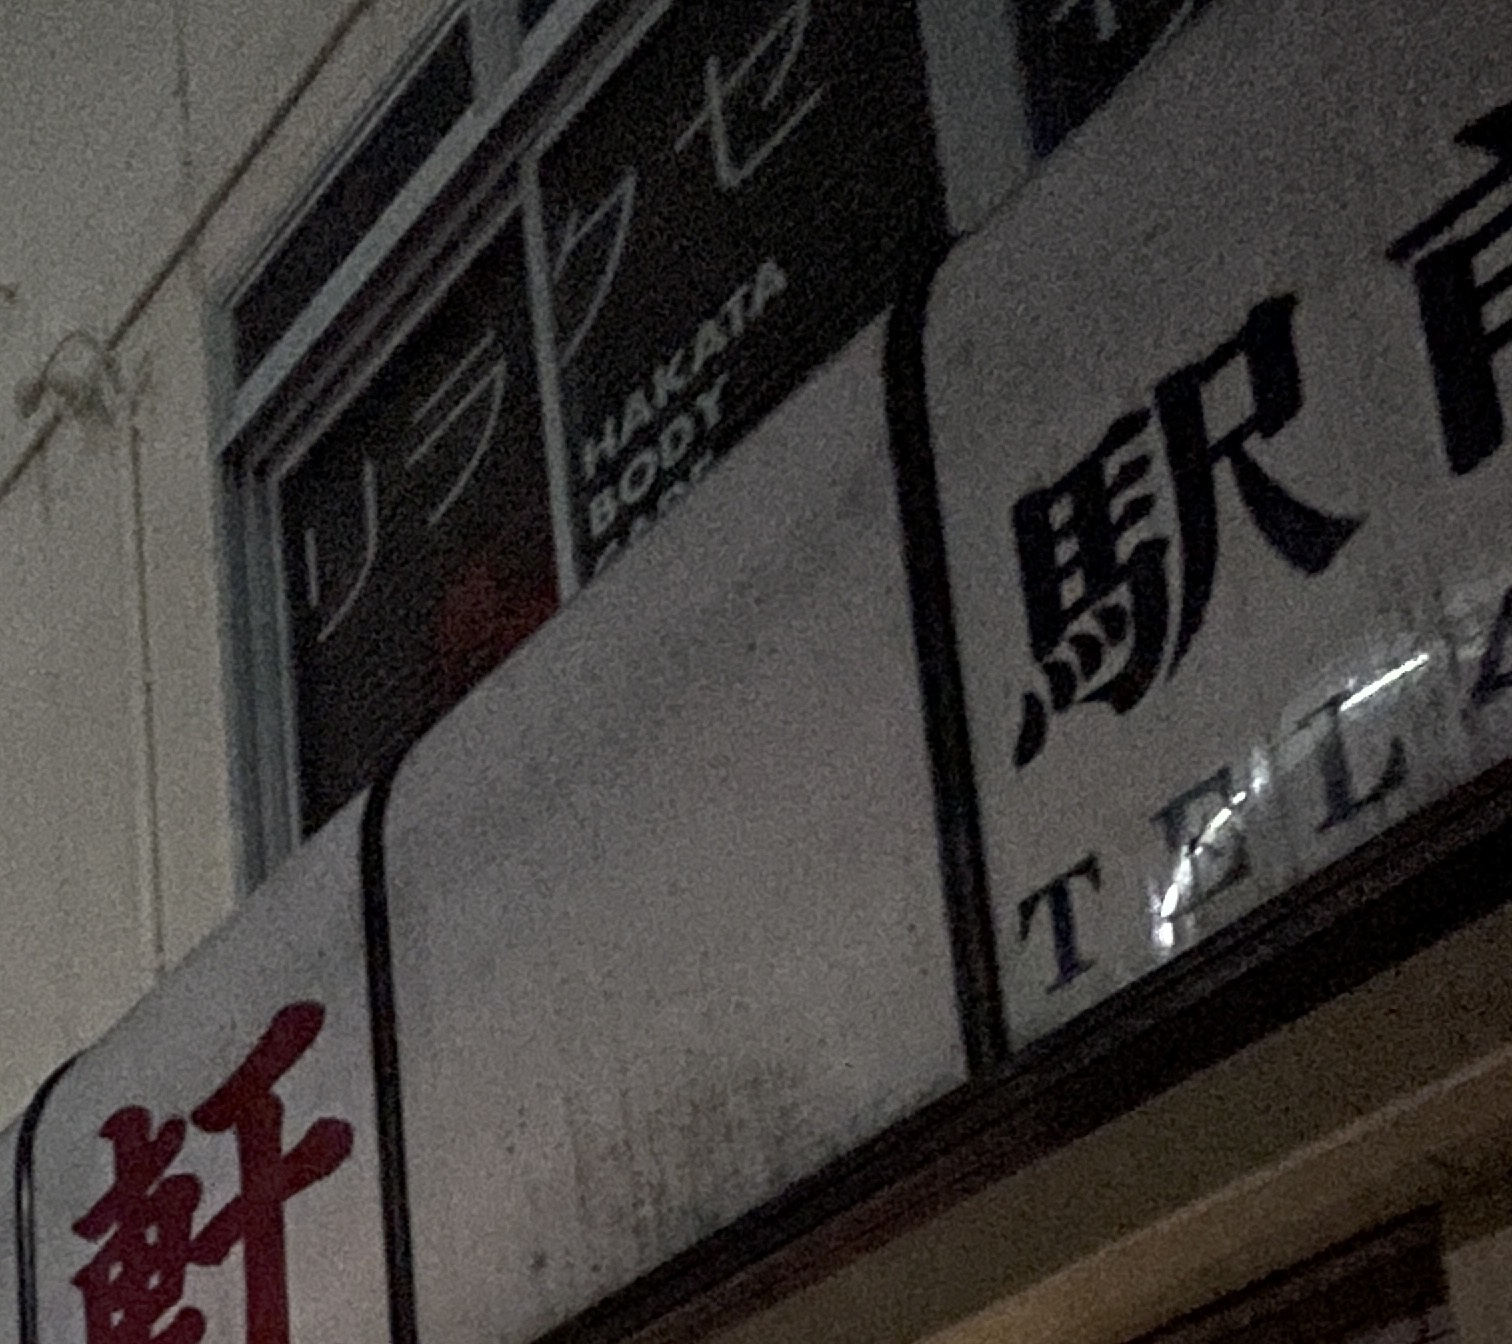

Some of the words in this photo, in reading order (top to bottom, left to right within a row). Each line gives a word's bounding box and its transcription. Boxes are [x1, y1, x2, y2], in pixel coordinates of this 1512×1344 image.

[584, 256, 788, 480] HAKATA
[589, 372, 728, 538] BODY
[1017, 692, 1408, 995] TEL
